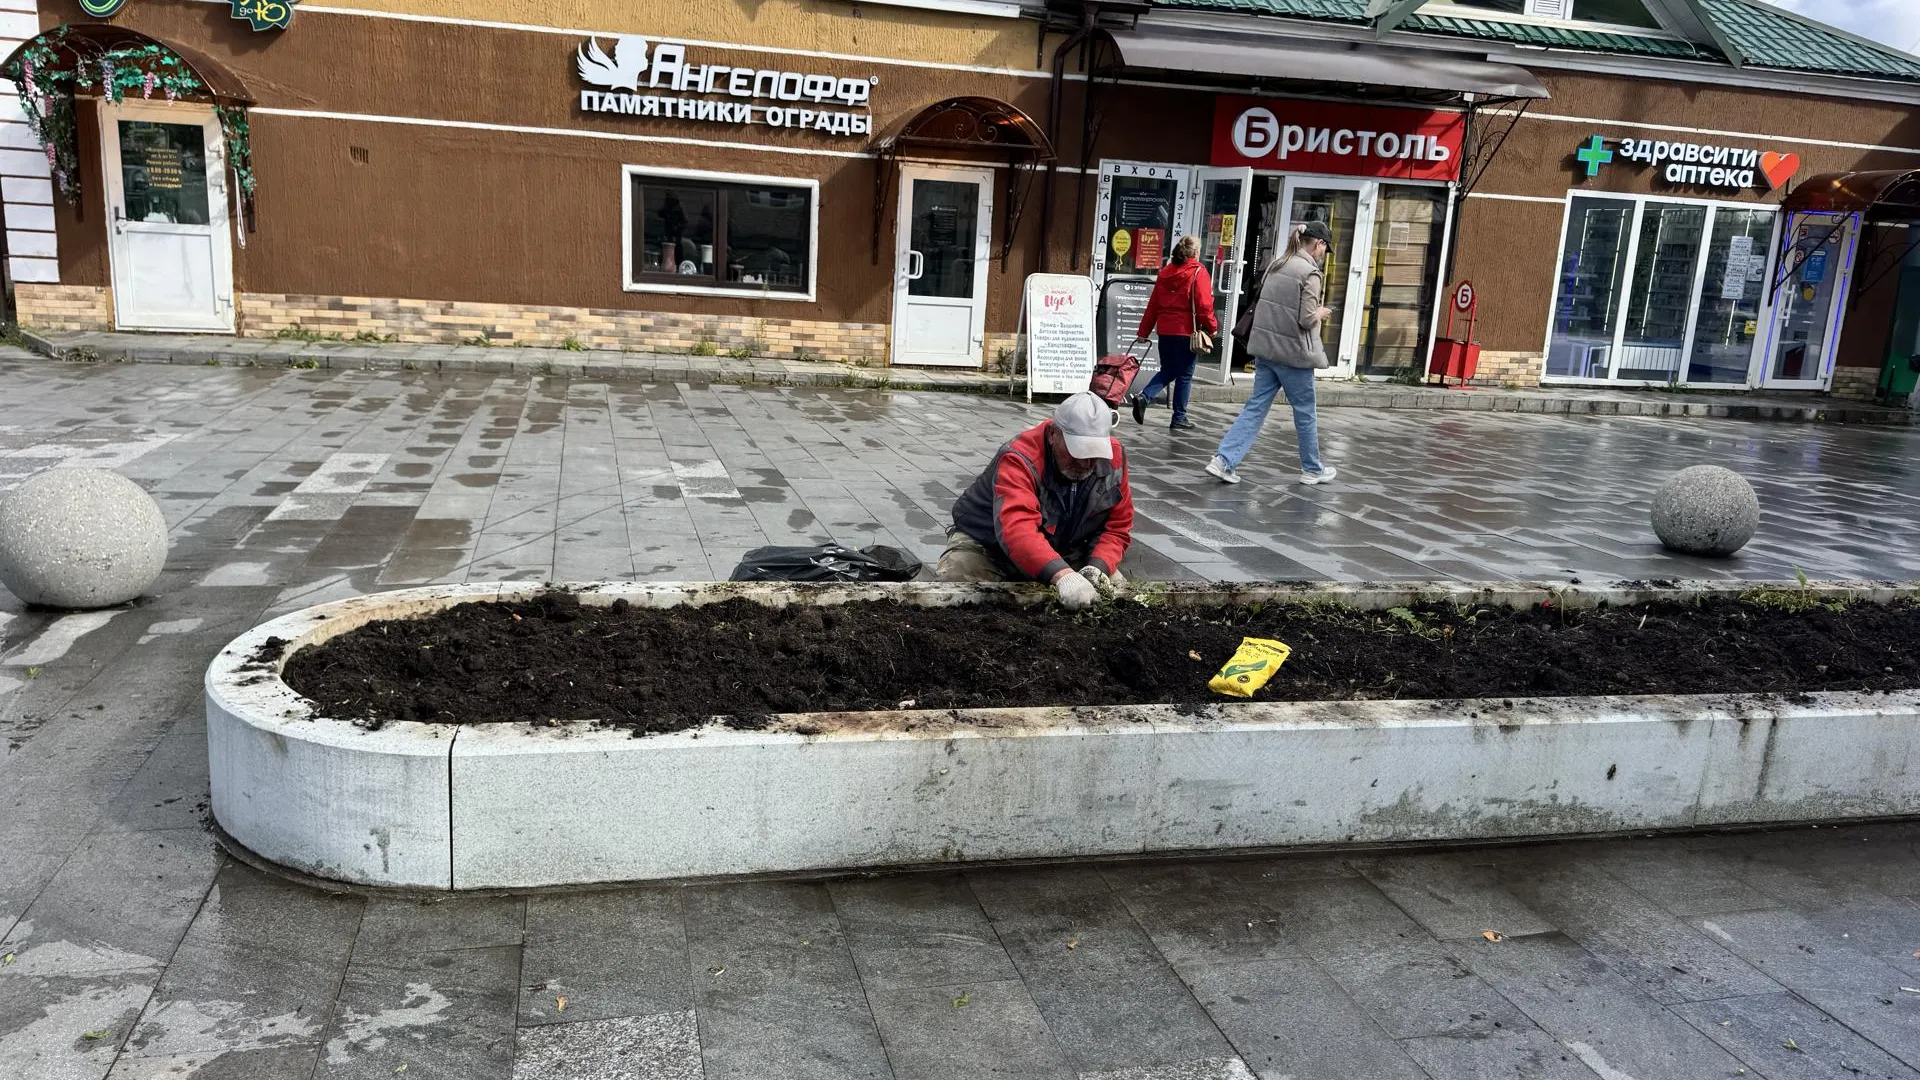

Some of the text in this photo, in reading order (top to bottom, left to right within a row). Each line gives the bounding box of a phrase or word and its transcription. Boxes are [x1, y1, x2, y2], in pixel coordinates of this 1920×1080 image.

[580, 89, 871, 136] ПАМЯТНИКИ ОГРАДЫ
[1245, 115, 1450, 162] Бристоль
[1619, 138, 1757, 168] здравсити
[1114, 165, 1173, 179] ВХОД
[1665, 163, 1754, 188] аптека
[1174, 191, 1185, 237] 2 ЭТАЖ
